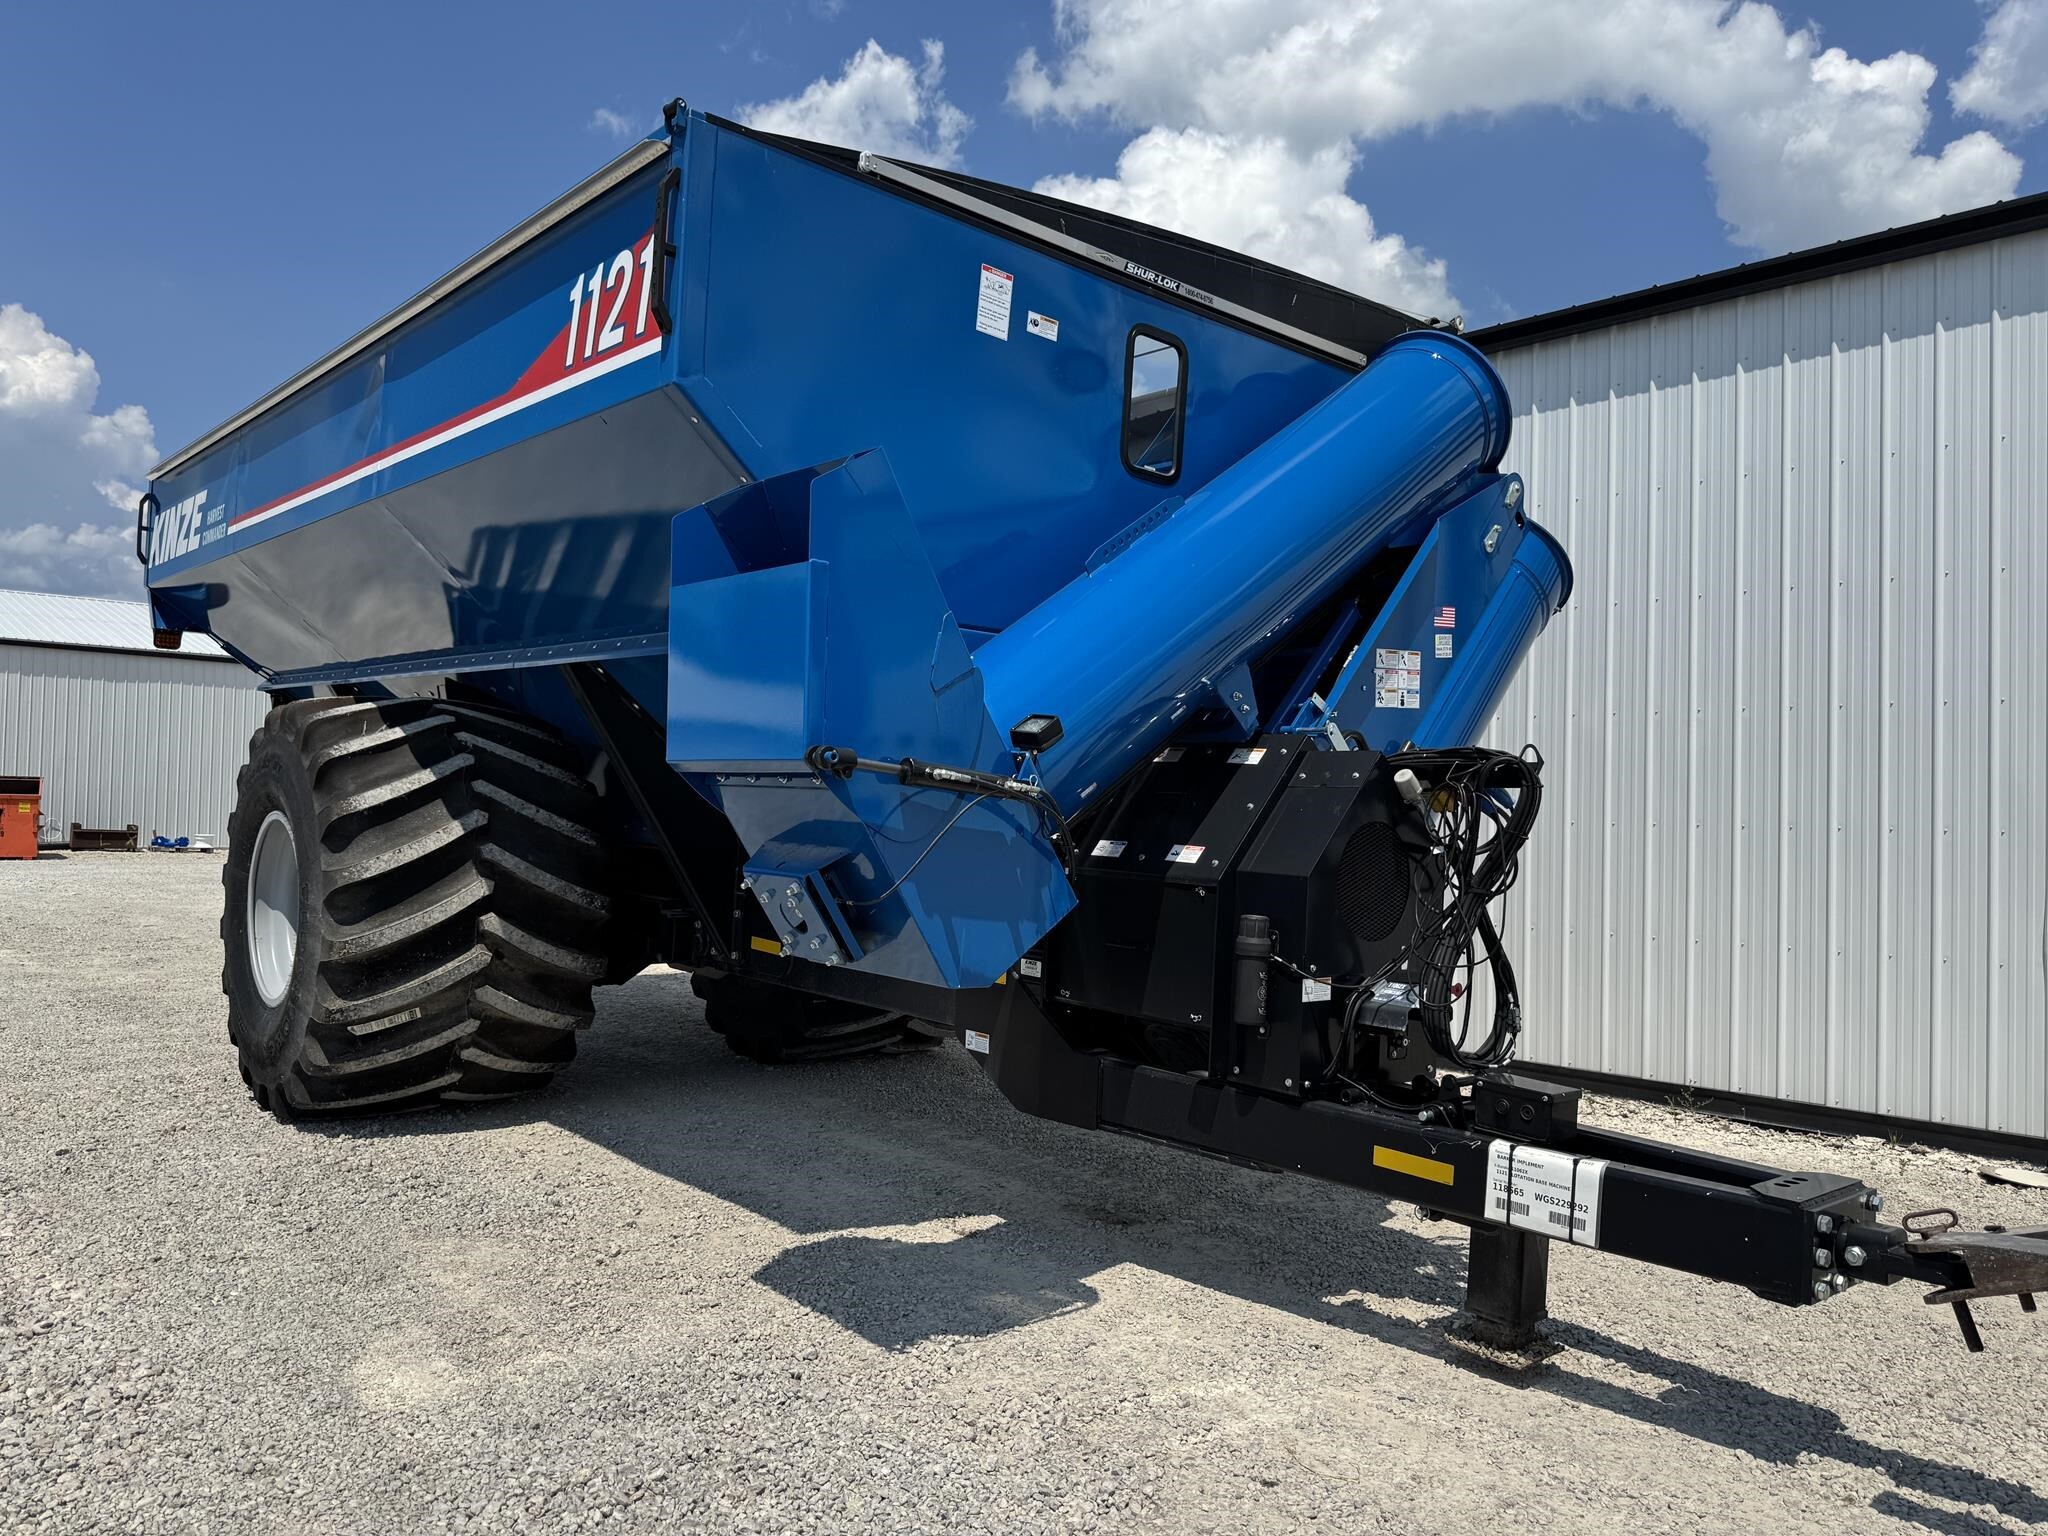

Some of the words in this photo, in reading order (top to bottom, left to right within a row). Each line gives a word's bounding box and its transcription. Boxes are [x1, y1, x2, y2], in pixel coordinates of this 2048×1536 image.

[565, 233, 654, 367] 1121
[148, 489, 208, 569] KINZE
[1517, 1159, 1544, 1170] IMPLEMENT
[1510, 1172, 1535, 1182] OTATION
[1535, 1178, 1547, 1186] BASE
[1548, 1182, 1571, 1192] MACHINE
[1534, 1192, 1589, 1214] WGS229292
